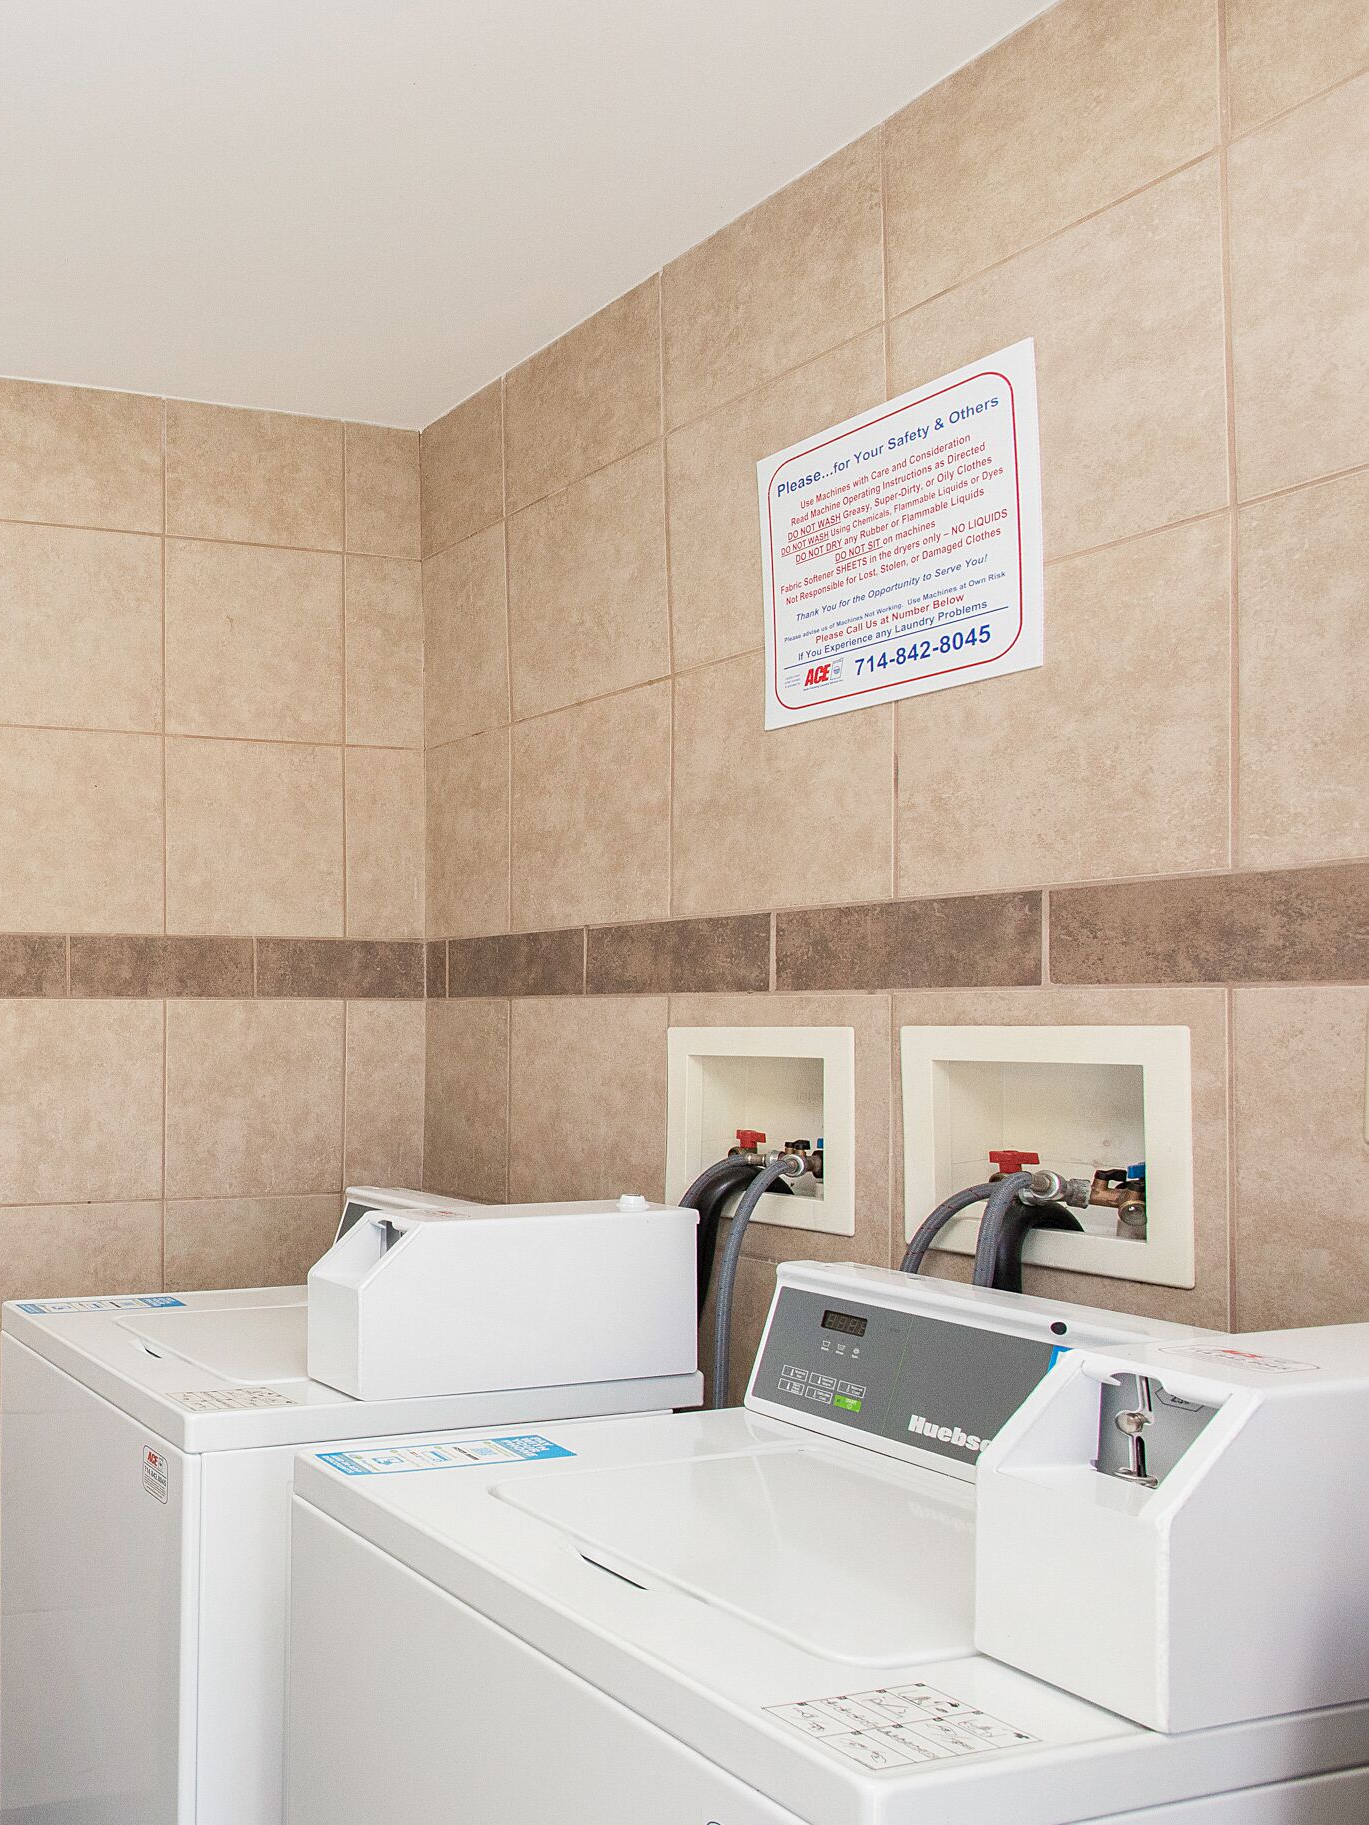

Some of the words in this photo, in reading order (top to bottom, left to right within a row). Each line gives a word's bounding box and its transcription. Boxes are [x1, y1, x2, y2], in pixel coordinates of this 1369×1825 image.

[777, 459, 850, 497] Please...for
[854, 445, 884, 464] Your
[888, 425, 930, 450] Safety
[934, 418, 944, 431] &
[949, 397, 999, 424] Others
[791, 514, 811, 526] Read
[811, 503, 841, 518] Machine
[843, 484, 880, 505] Operating
[883, 464, 932, 489] Instructions
[935, 460, 944, 469] as
[948, 442, 986, 464] Directed
[801, 499, 813, 509] Use
[816, 484, 850, 503] Machines
[852, 476, 869, 488] with
[871, 466, 890, 480] Care
[892, 456, 907, 473] and
[910, 435, 971, 464] Consideration
[781, 547, 791, 557] DO
[792, 540, 807, 550] NOT
[808, 532, 829, 544] WASH
[830, 525, 850, 538] Using
[852, 509, 892, 528] Chemicals,
[894, 493, 936, 513] Flammable
[938, 480, 968, 496] Liquids
[971, 474, 979, 484] or
[982, 467, 1003, 480] Dyes
[788, 529, 799, 541] DO
[800, 524, 816, 534] NOT
[818, 514, 841, 528] WASH
[843, 503, 872, 519] Greasy,
[874, 483, 923, 507] Super-Dirty,
[926, 478, 935, 487] or
[937, 471, 954, 483] Oily
[957, 457, 992, 475] Clothes
[796, 552, 807, 564] DO
[808, 545, 824, 557] NOT
[826, 539, 842, 551] DRY
[844, 536, 859, 546] any
[860, 524, 888, 539] Rubber
[891, 519, 899, 528] or
[902, 502, 948, 524] Flammable
[951, 488, 984, 506] Liquids
[780, 580, 802, 594] Fabric
[804, 570, 834, 586] Softener
[836, 558, 867, 574] SHEETS
[870, 555, 877, 563] in
[879, 548, 891, 559] the
[894, 541, 920, 555] dryers
[923, 532, 941, 545] only
[952, 524, 965, 536] NO
[968, 509, 1008, 529] LIQUIDS
[785, 596, 799, 605] Not
[800, 579, 845, 601] Responsible
[846, 574, 856, 583] for
[880, 559, 909, 574] Stolen,
[911, 554, 920, 564] or
[922, 538, 963, 560] Damaged
[966, 528, 1001, 545] Clothes
[835, 551, 847, 563] DO
[849, 544, 865, 556] NOT
[867, 539, 881, 550] SIT
[883, 536, 893, 544] on
[896, 521, 936, 540] machines
[784, 634, 801, 642] Please
[803, 628, 820, 637] advise
[836, 613, 863, 626] Machines
[876, 602, 904, 614] Working.
[907, 598, 921, 606] Use
[923, 587, 957, 600] Machines
[969, 577, 986, 587] Own
[988, 571, 1006, 581] Risk
[796, 608, 819, 621] Thank
[822, 604, 837, 613] You
[838, 599, 851, 608] for
[853, 595, 865, 603] the
[867, 576, 921, 598] Opportunity
[923, 574, 931, 582] to
[934, 565, 961, 578] Serve
[965, 554, 988, 568] You!
[816, 629, 843, 643] Please
[847, 623, 862, 634] Call
[866, 620, 877, 629] Us
[881, 616, 889, 624] at
[892, 604, 930, 621] Number
[933, 594, 965, 609] Below
[798, 650, 805, 660] If
[806, 648, 822, 658] You
[825, 634, 873, 653] Experience
[876, 629, 892, 638] any
[895, 615, 935, 633] Laundry
[938, 601, 988, 621] Problems
[804, 663, 831, 686] ACE
[854, 624, 991, 676] 714-842-8045
[908, 1414, 994, 1452] Huebsc
